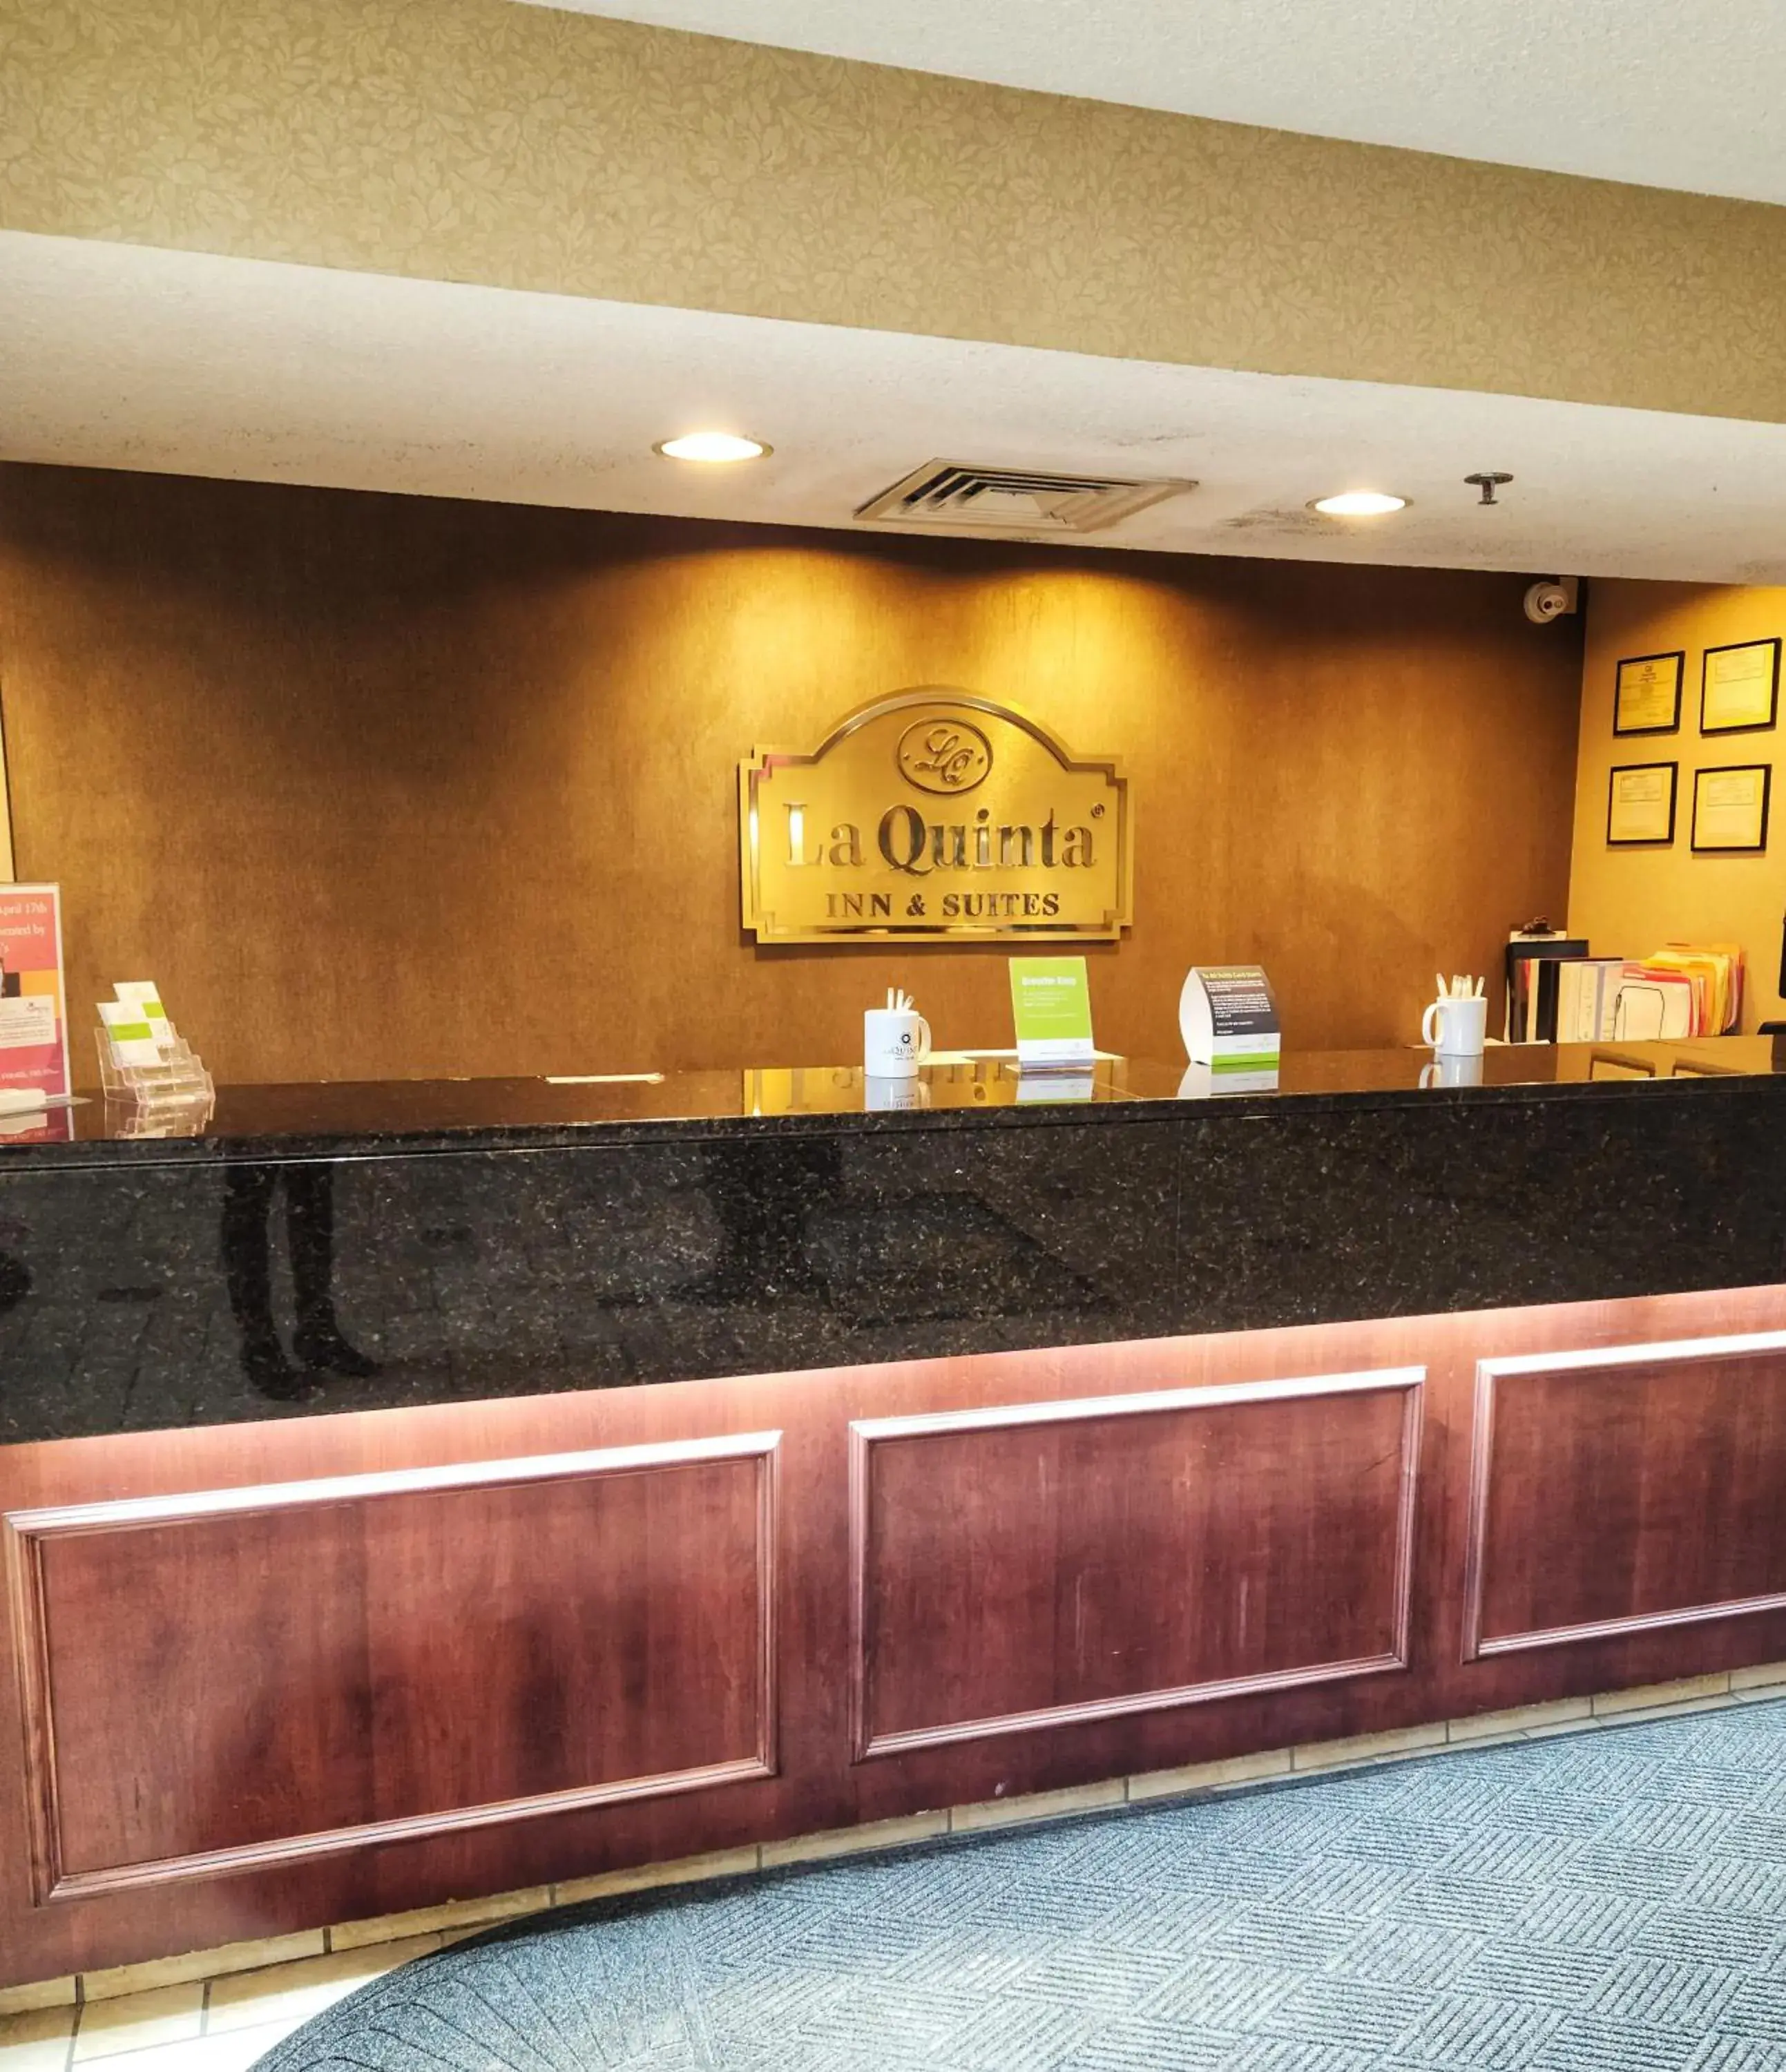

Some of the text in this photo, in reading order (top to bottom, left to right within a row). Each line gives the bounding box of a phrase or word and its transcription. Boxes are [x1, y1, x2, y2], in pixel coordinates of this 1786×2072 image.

[782, 802, 867, 868] La
[826, 892, 1060, 918] INN & SUITES
